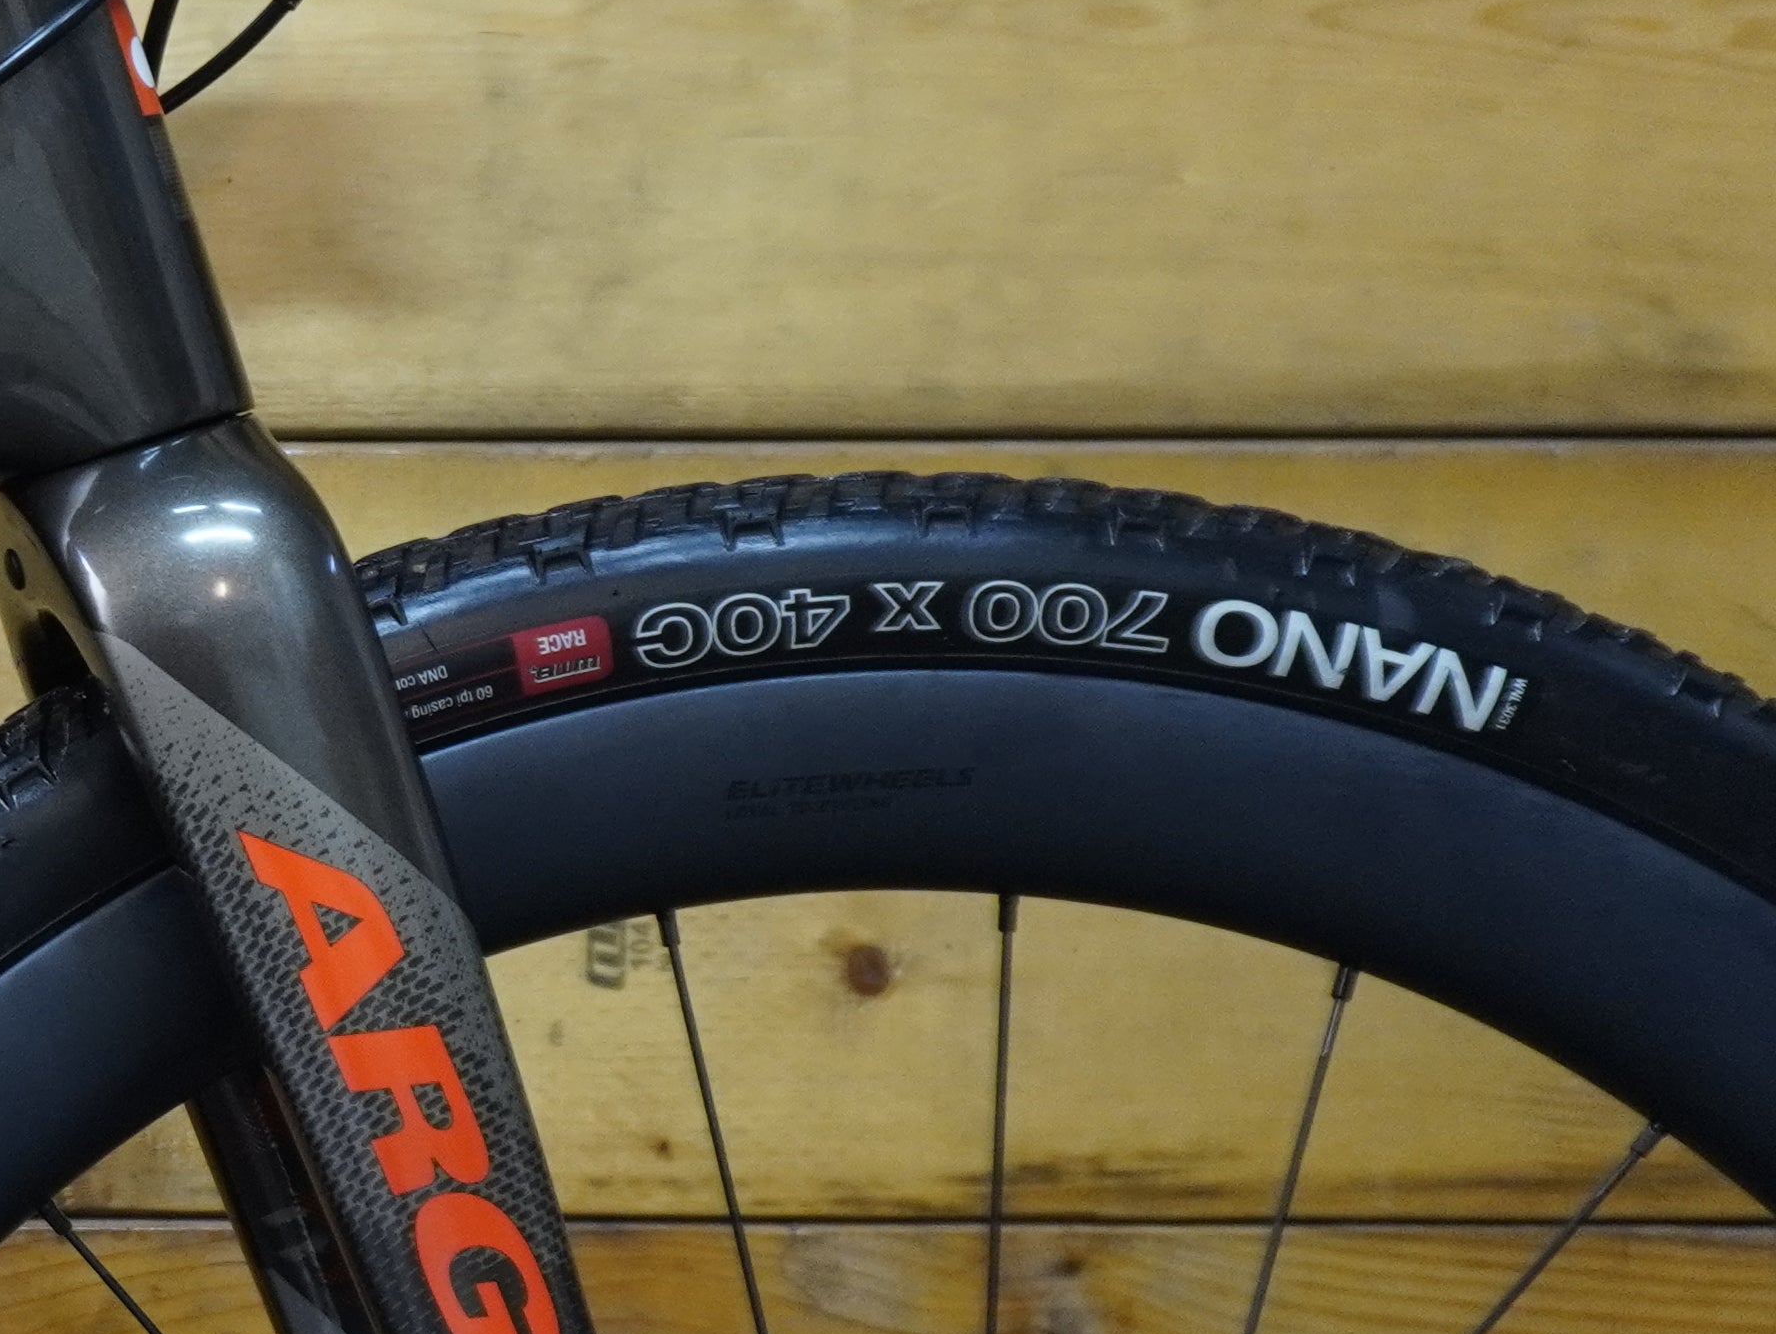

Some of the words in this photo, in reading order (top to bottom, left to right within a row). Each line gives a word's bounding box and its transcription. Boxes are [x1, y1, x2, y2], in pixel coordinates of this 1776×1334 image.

[635, 587, 851, 669] 40C
[968, 578, 1170, 654] 700
[536, 627, 588, 655] RACE
[417, 664, 449, 684] DNA
[1199, 598, 1508, 732] NANO
[476, 683, 494, 700] 60
[411, 693, 454, 719] casing
